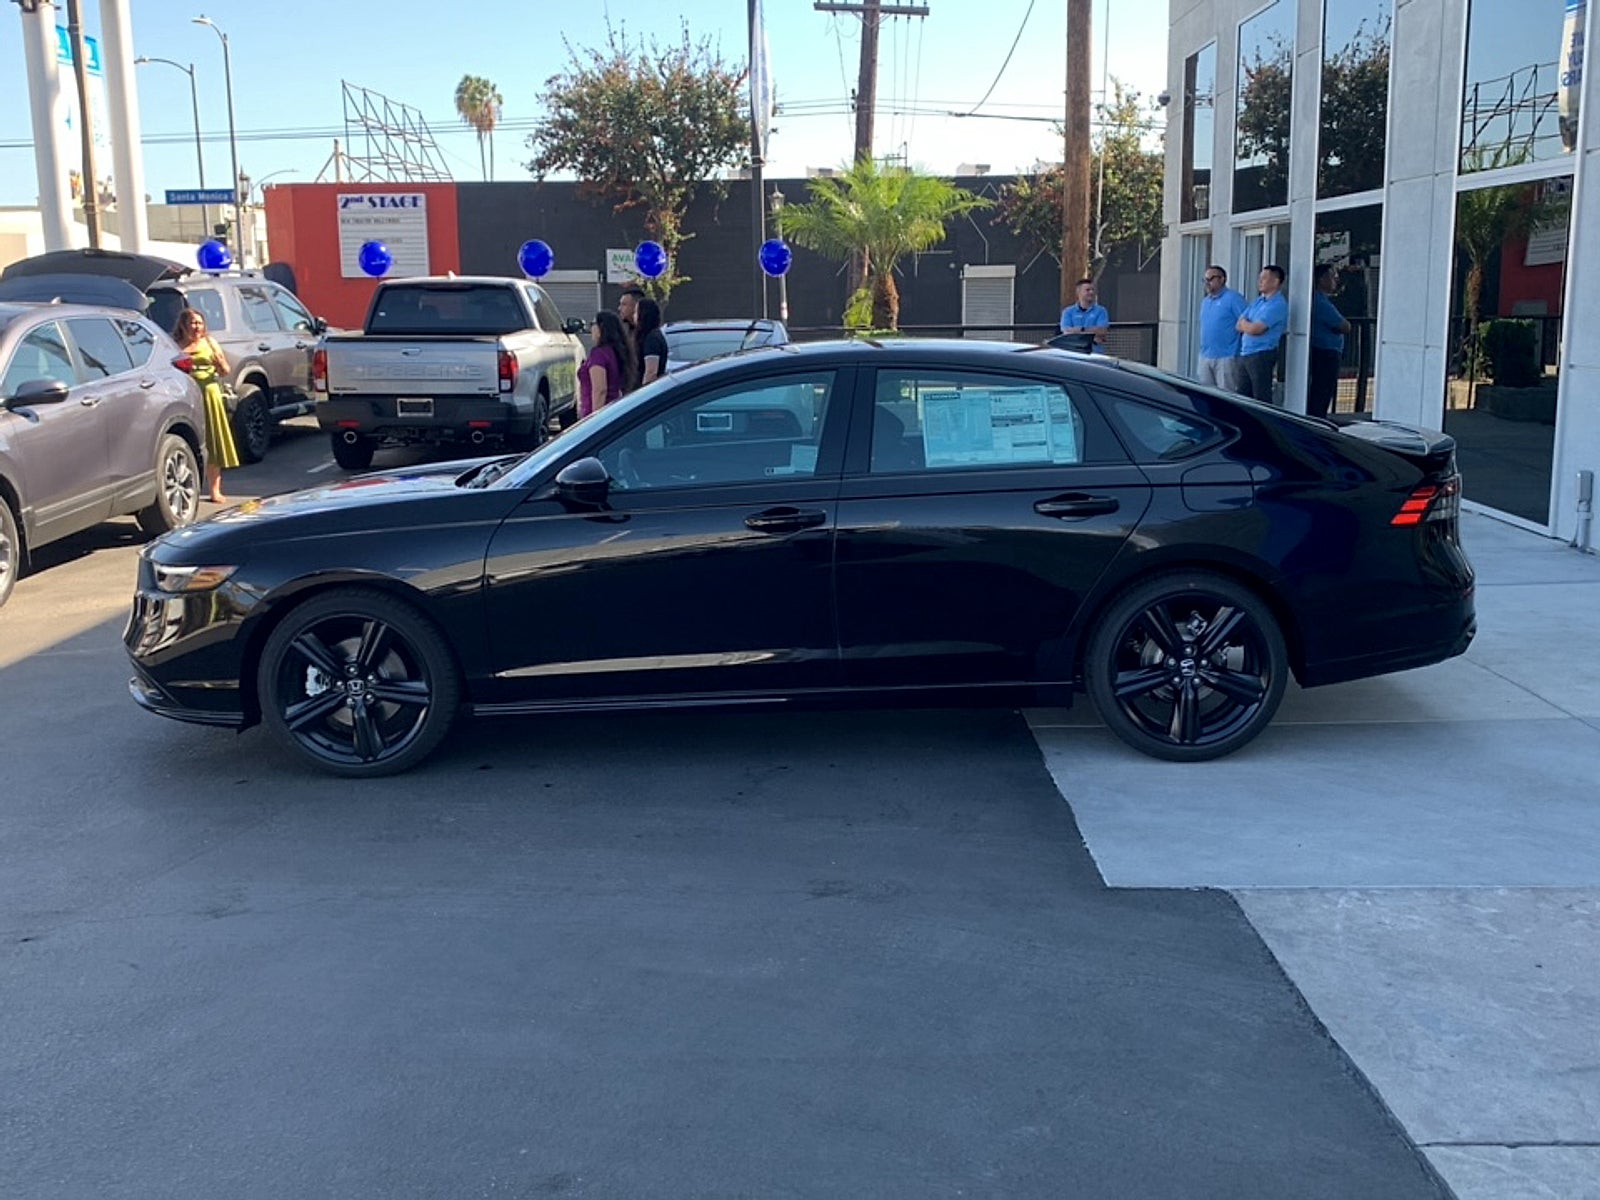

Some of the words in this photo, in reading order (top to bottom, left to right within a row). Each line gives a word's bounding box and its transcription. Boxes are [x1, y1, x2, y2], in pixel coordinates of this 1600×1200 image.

[169, 191, 195, 202] Santa
[198, 191, 229, 202] Monica
[340, 196, 364, 209] 2nd
[368, 195, 422, 208] STAGE
